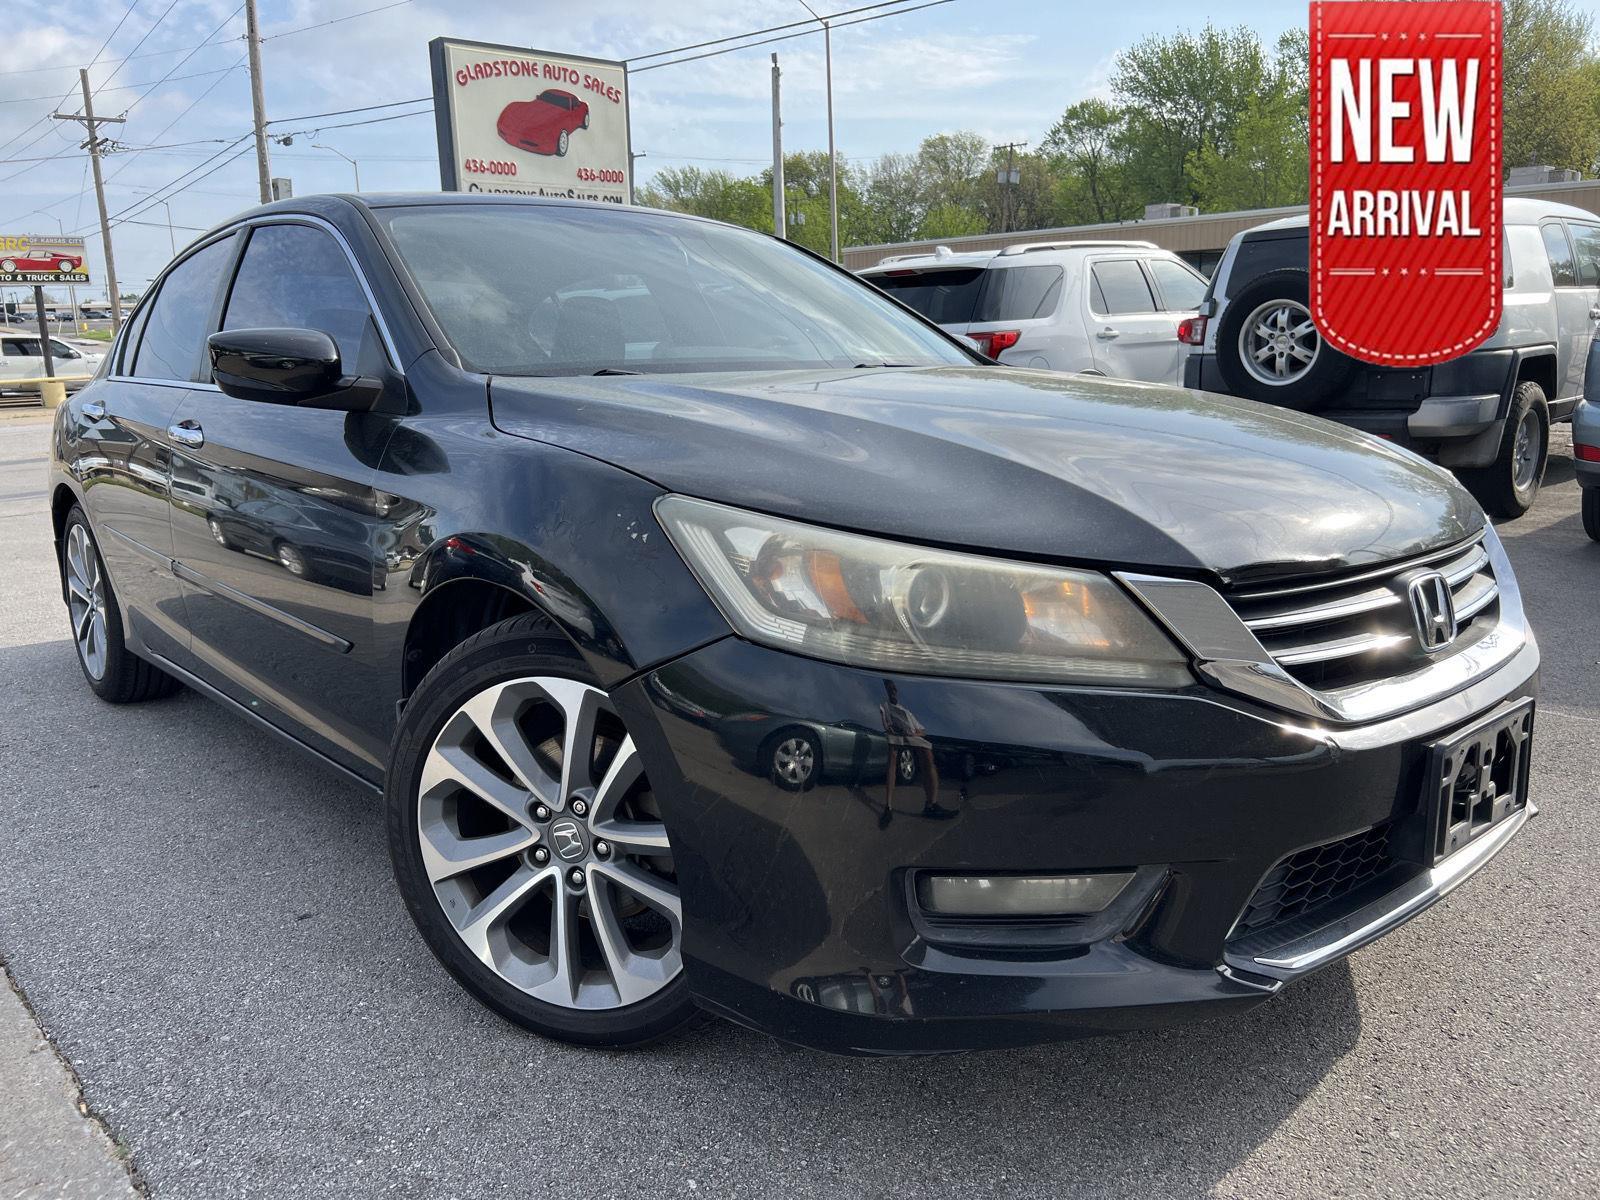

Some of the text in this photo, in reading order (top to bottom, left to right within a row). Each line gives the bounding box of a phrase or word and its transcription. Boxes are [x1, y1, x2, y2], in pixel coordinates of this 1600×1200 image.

[456, 60, 622, 104] GLADSTONE AUTO SALES
[464, 158, 517, 176] 436-0000
[577, 167, 625, 184] 436-0000
